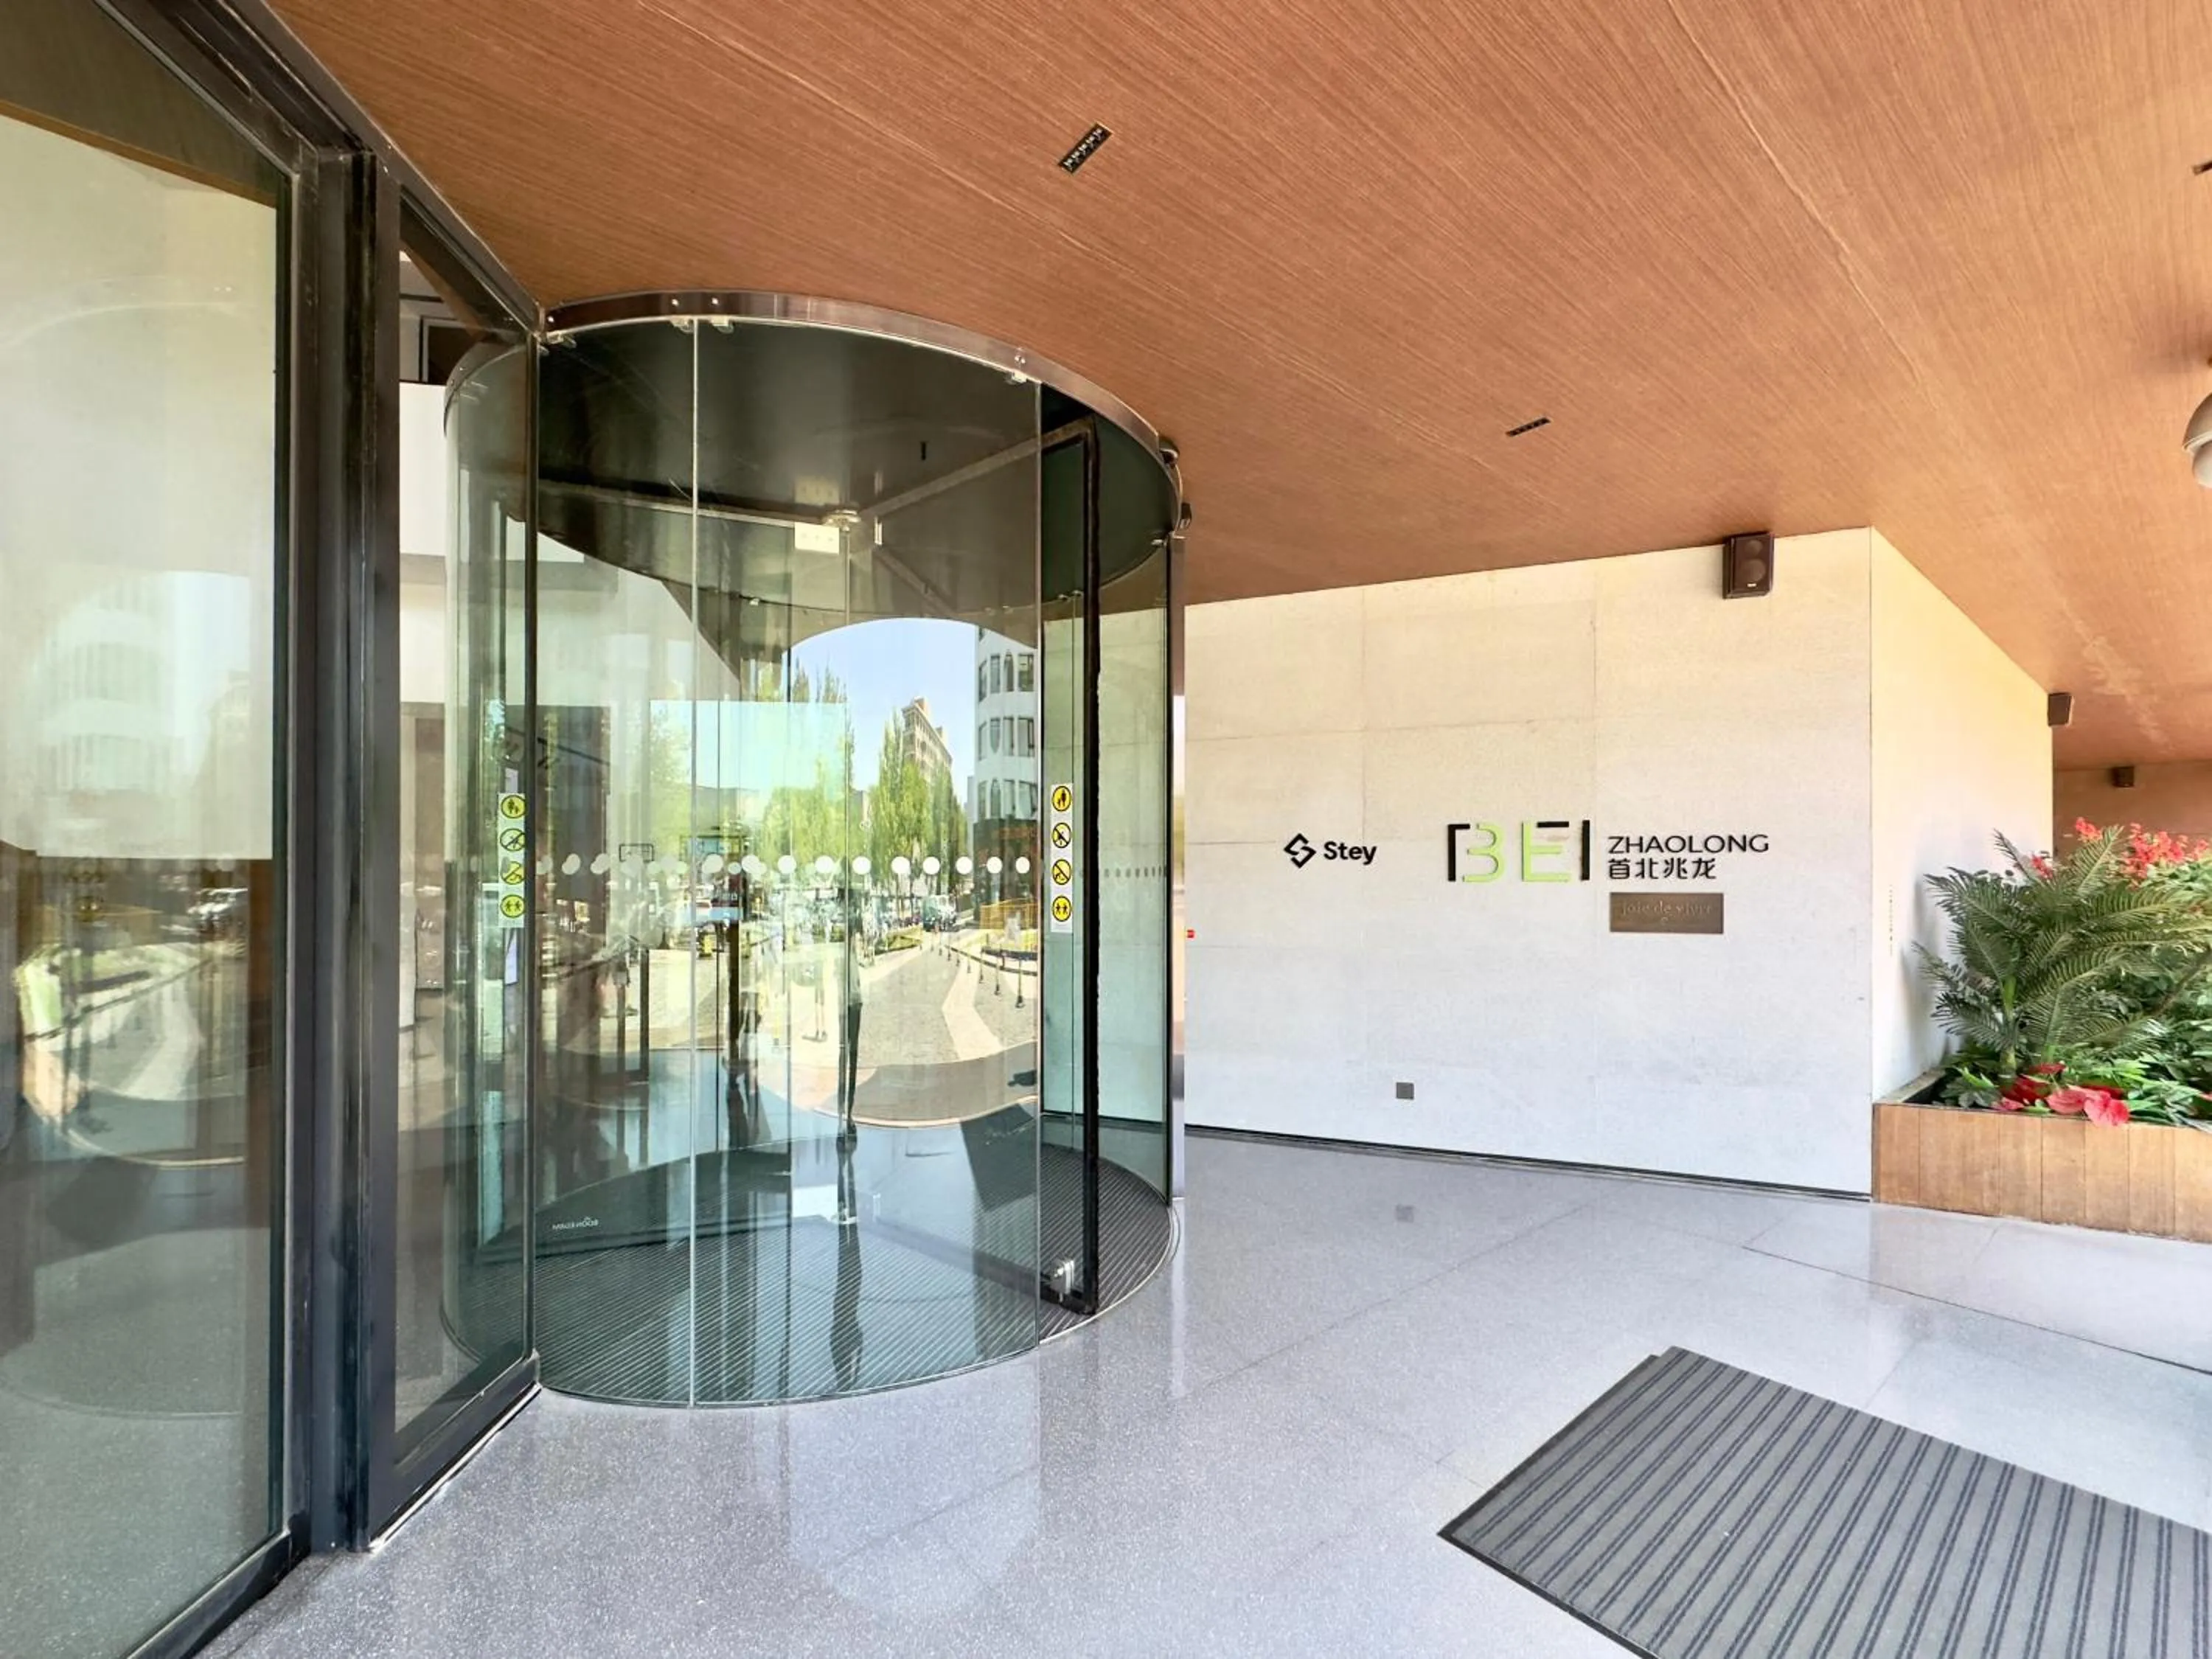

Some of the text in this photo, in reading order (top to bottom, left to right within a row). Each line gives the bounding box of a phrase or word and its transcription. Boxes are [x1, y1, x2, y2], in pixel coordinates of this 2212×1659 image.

[1324, 841, 1377, 866] Stey
[1447, 820, 1590, 883] BEI
[1608, 834, 1769, 854] ZHAOLONG
[1608, 858, 1717, 880] 首北兆龙
